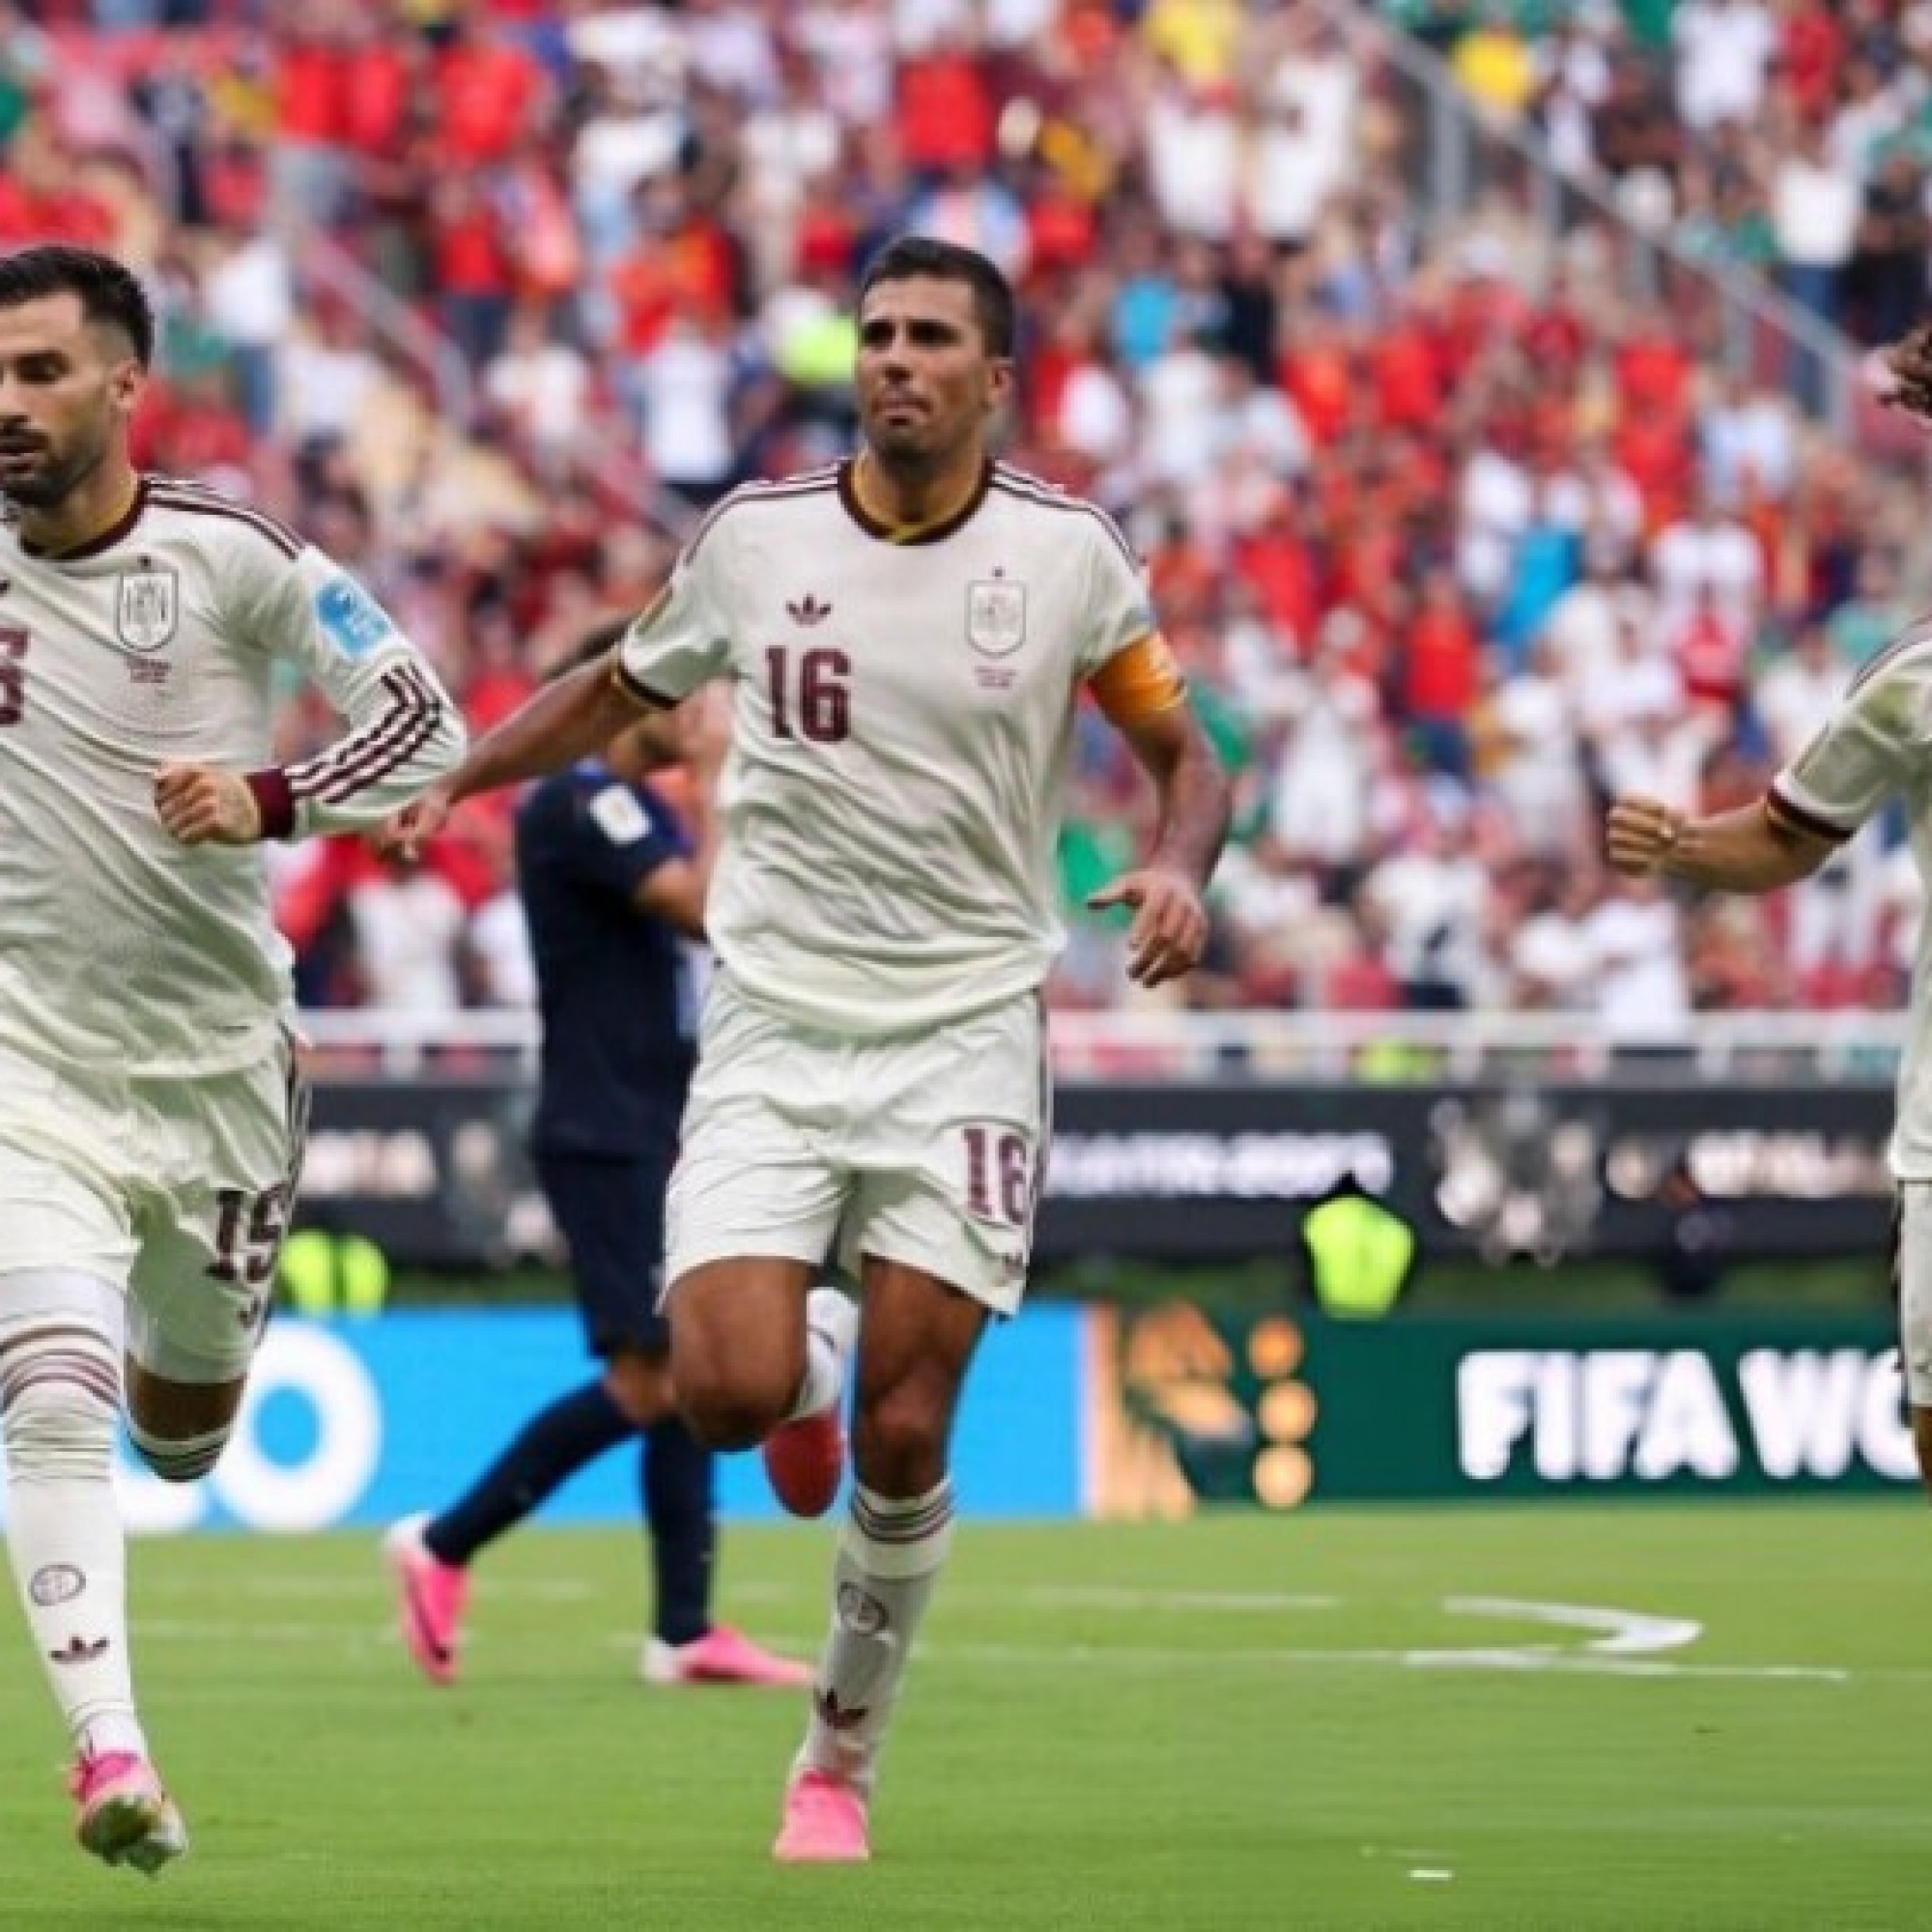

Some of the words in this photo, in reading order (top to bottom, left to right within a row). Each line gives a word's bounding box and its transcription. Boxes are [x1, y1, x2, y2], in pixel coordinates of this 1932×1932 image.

[765, 645, 851, 741] 16
[962, 1127, 1028, 1226] 16
[204, 1180, 291, 1283] 15
[1458, 1350, 1740, 1480] FIFA
